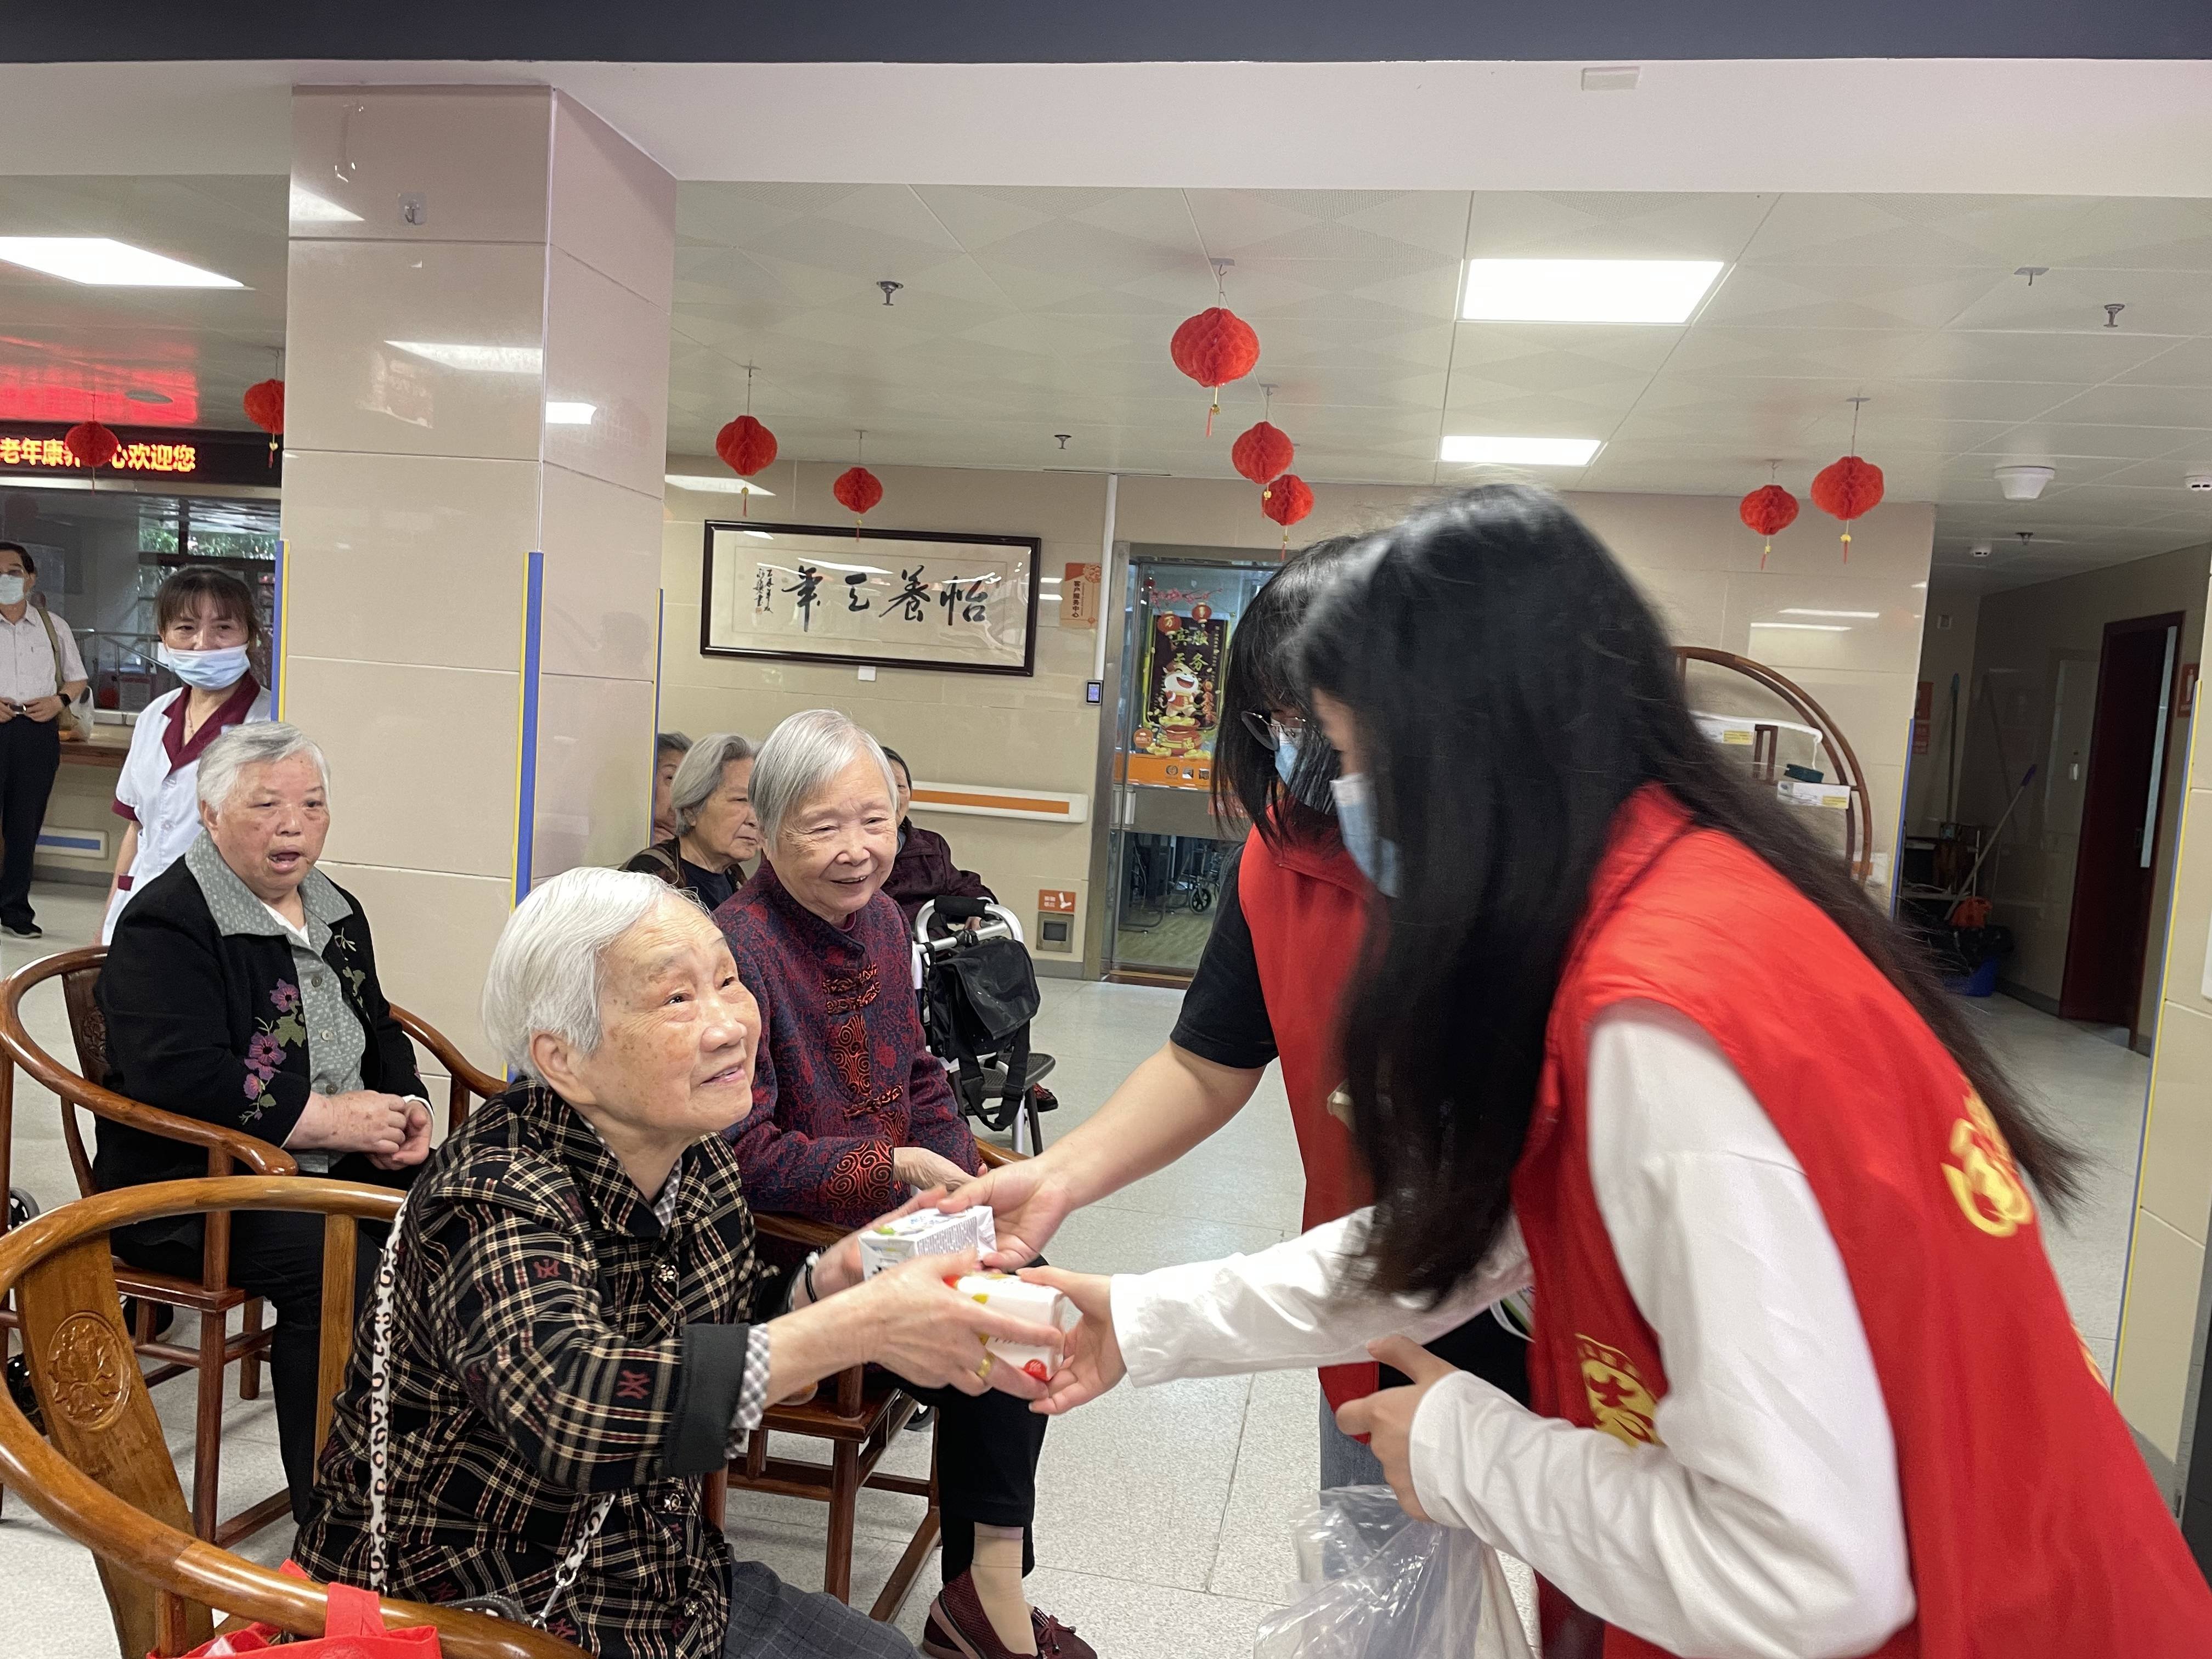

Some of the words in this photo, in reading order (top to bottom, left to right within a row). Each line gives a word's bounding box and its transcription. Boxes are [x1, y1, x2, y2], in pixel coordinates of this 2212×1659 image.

[1071, 580, 1081, 618] 客户服务中心
